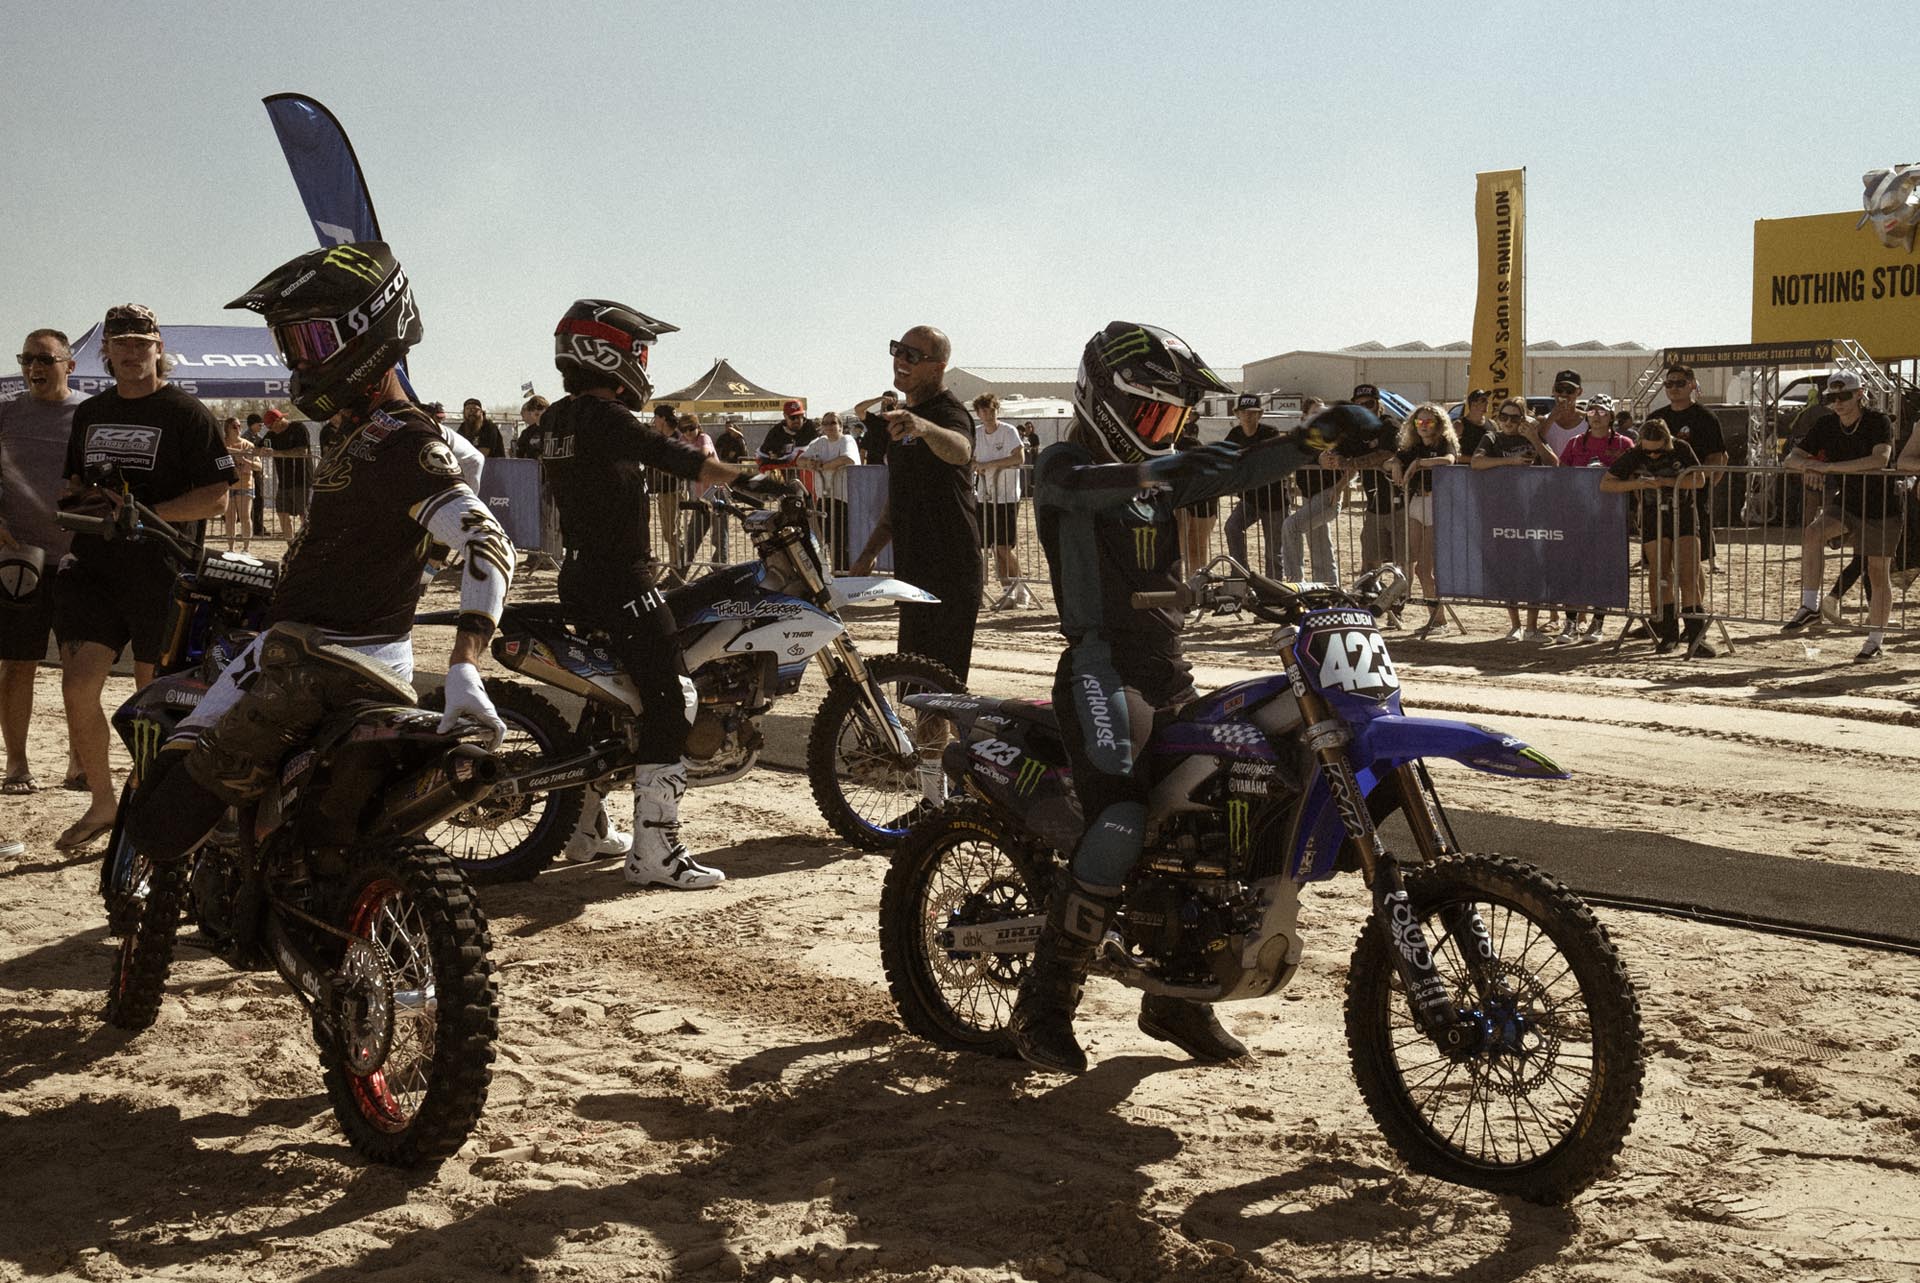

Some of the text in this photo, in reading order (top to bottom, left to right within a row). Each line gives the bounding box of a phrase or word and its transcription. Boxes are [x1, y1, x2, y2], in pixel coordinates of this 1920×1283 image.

[1495, 190, 1511, 275] NOTHING
[370, 267, 407, 319] SCO
[1772, 269, 1865, 306] NOTHING
[1495, 281, 1510, 344] STOPS
[346, 343, 389, 384] MONSTER
[1682, 348, 1811, 362] RAM THRILL RIDE EXPERIENCE STARTS HERE
[90, 428, 156, 443] RZR
[1095, 404, 1132, 452] MONSTER
[106, 456, 151, 465] MOTORSPORTS
[489, 497, 510, 507] RZR
[1493, 527, 1564, 541] POLARIS
[205, 557, 276, 578] RENTHAL
[203, 568, 274, 589] RENTHAL
[712, 600, 802, 617] THRILL SEEKERS
[1216, 602, 1242, 613] ASV
[1341, 612, 1372, 626] GOLDEN
[791, 631, 814, 639] THOR
[1319, 632, 1400, 692] 423
[176, 690, 202, 705] YAMA
[926, 700, 979, 710] DUNLOP
[980, 715, 1012, 725] ASV
[1082, 674, 1116, 750] STHOUSE
[970, 738, 1021, 767] 423
[1235, 779, 1268, 794] YAMAHA
[952, 820, 999, 840] DUNLOP
